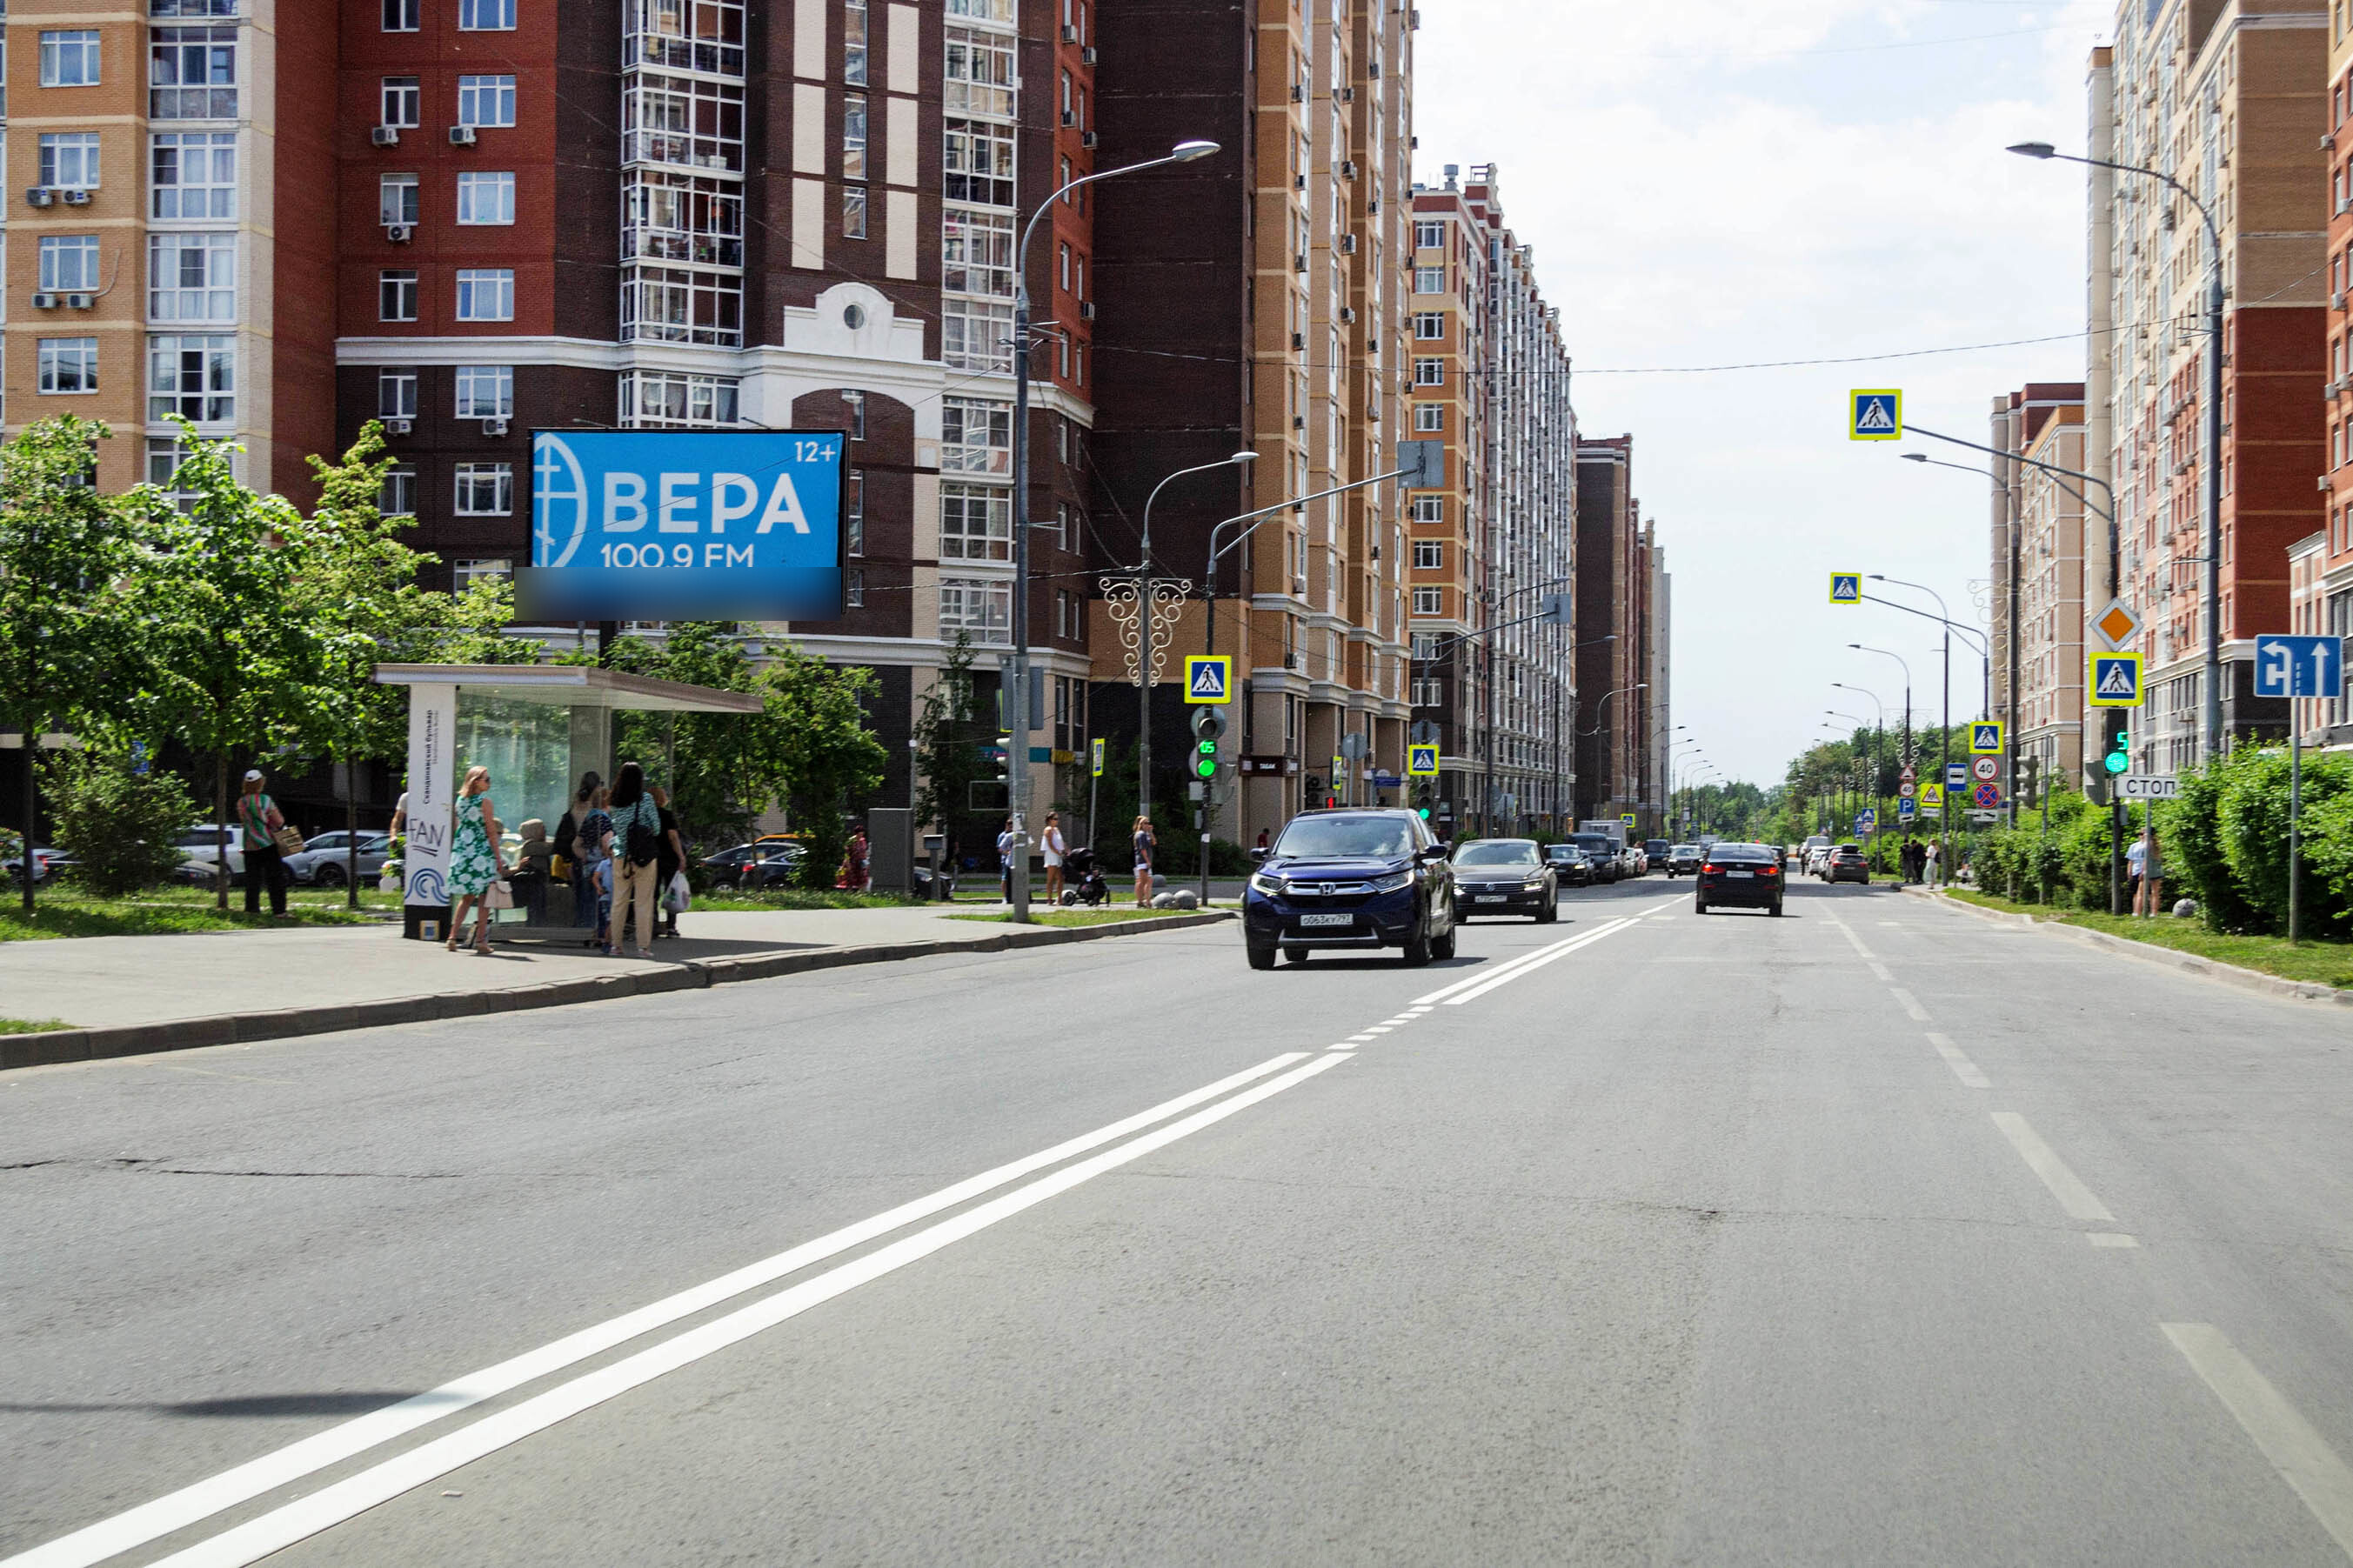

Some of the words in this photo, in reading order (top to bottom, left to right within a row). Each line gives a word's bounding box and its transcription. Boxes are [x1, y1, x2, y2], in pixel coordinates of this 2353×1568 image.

[794, 441, 836, 463] 12+
[603, 471, 811, 534] ВЕРА
[600, 543, 694, 567] 1009
[705, 544, 755, 567] FM
[2116, 731, 2129, 751] 5
[1978, 764, 1993, 774] 40
[2126, 779, 2176, 795] СТОП
[408, 817, 446, 847] FAN
